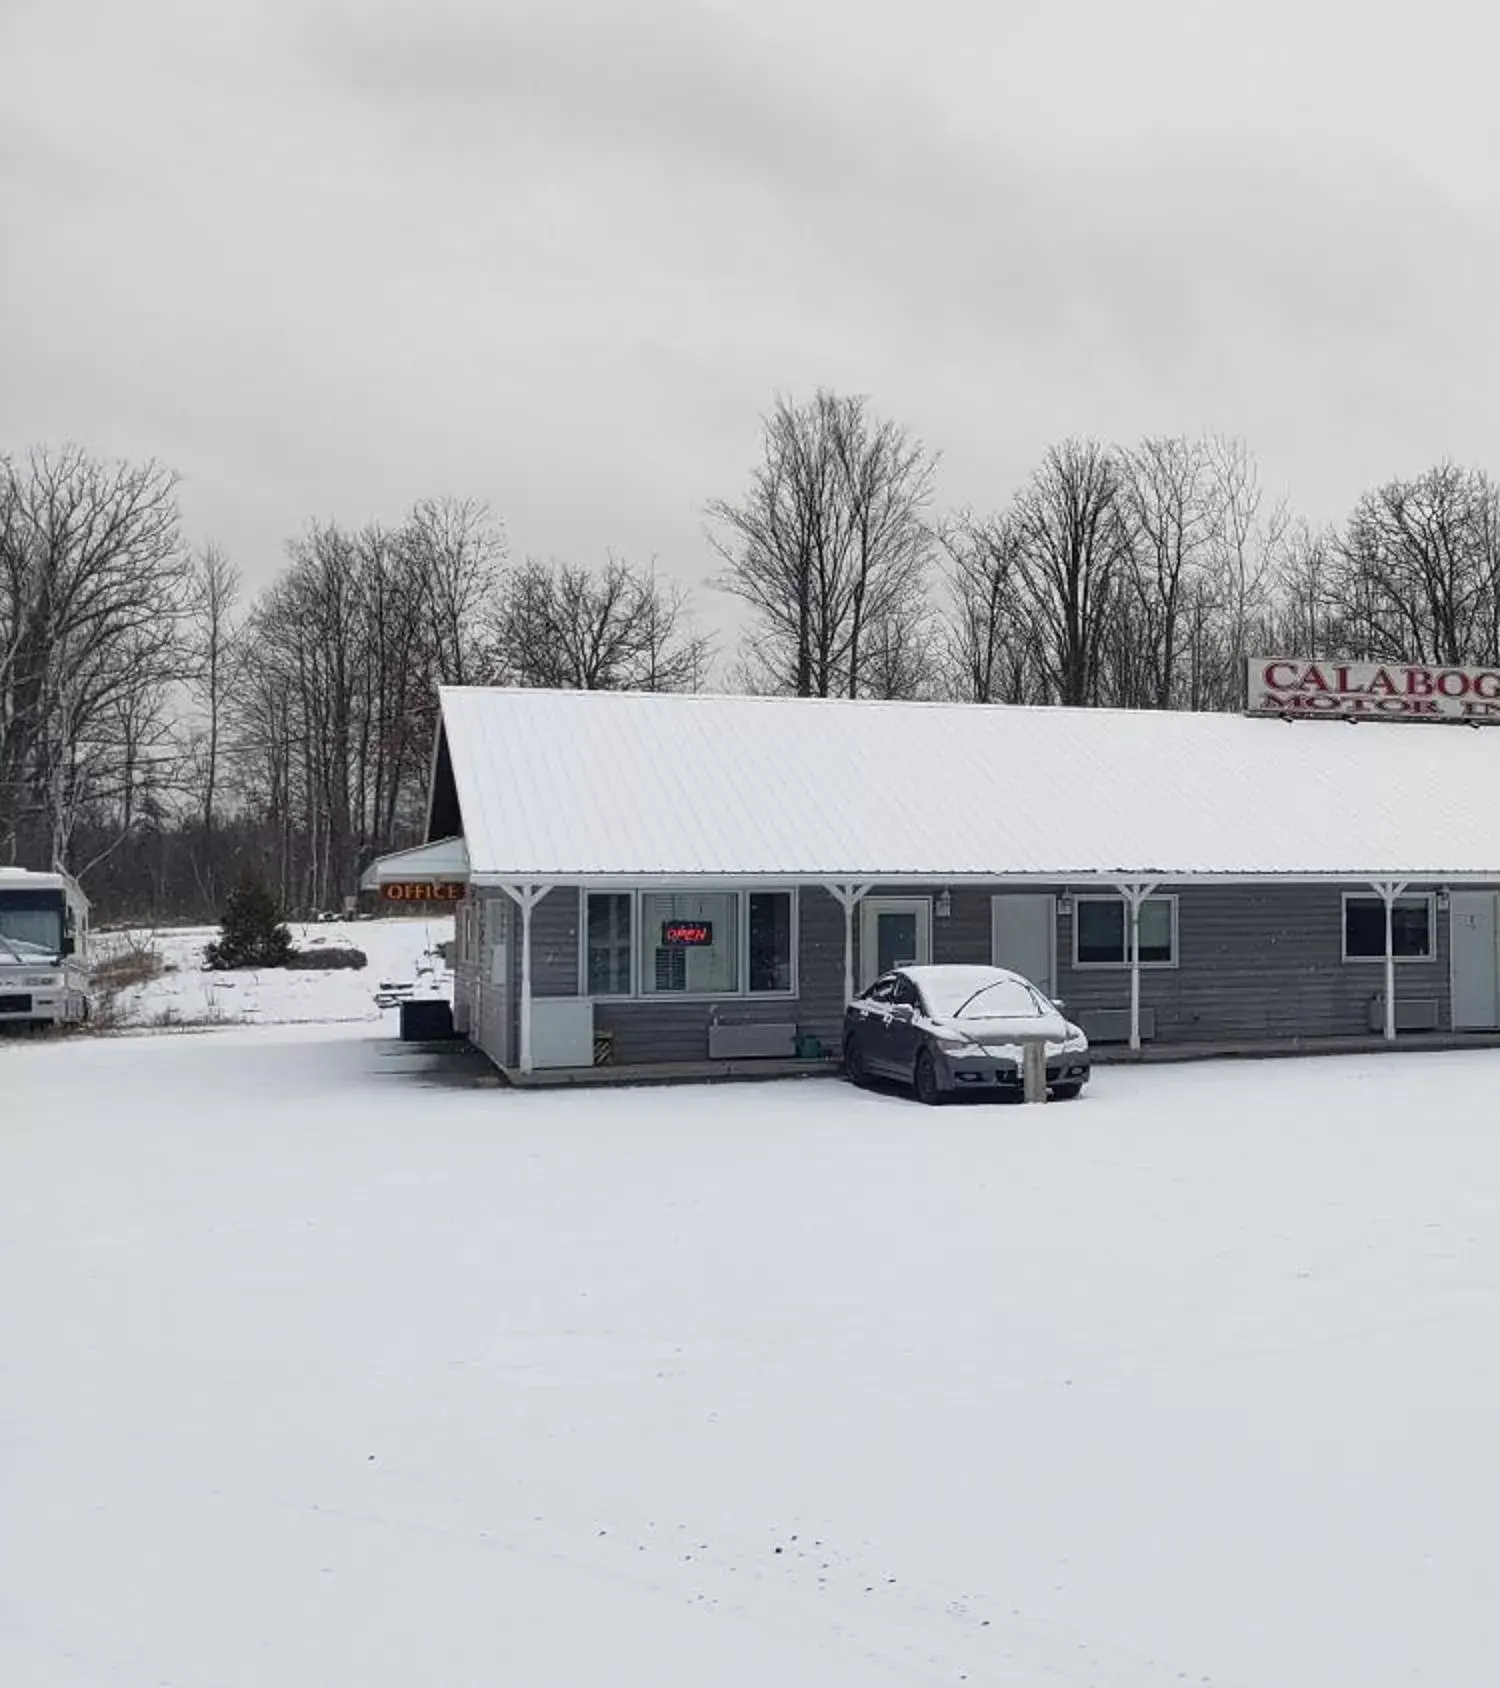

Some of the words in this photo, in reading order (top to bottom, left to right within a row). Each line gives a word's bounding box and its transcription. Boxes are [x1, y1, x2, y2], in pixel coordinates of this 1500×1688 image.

[1259, 694, 1444, 714] MOTOR
[386, 884, 457, 899] OFFICE
[667, 927, 707, 941] OPEN
